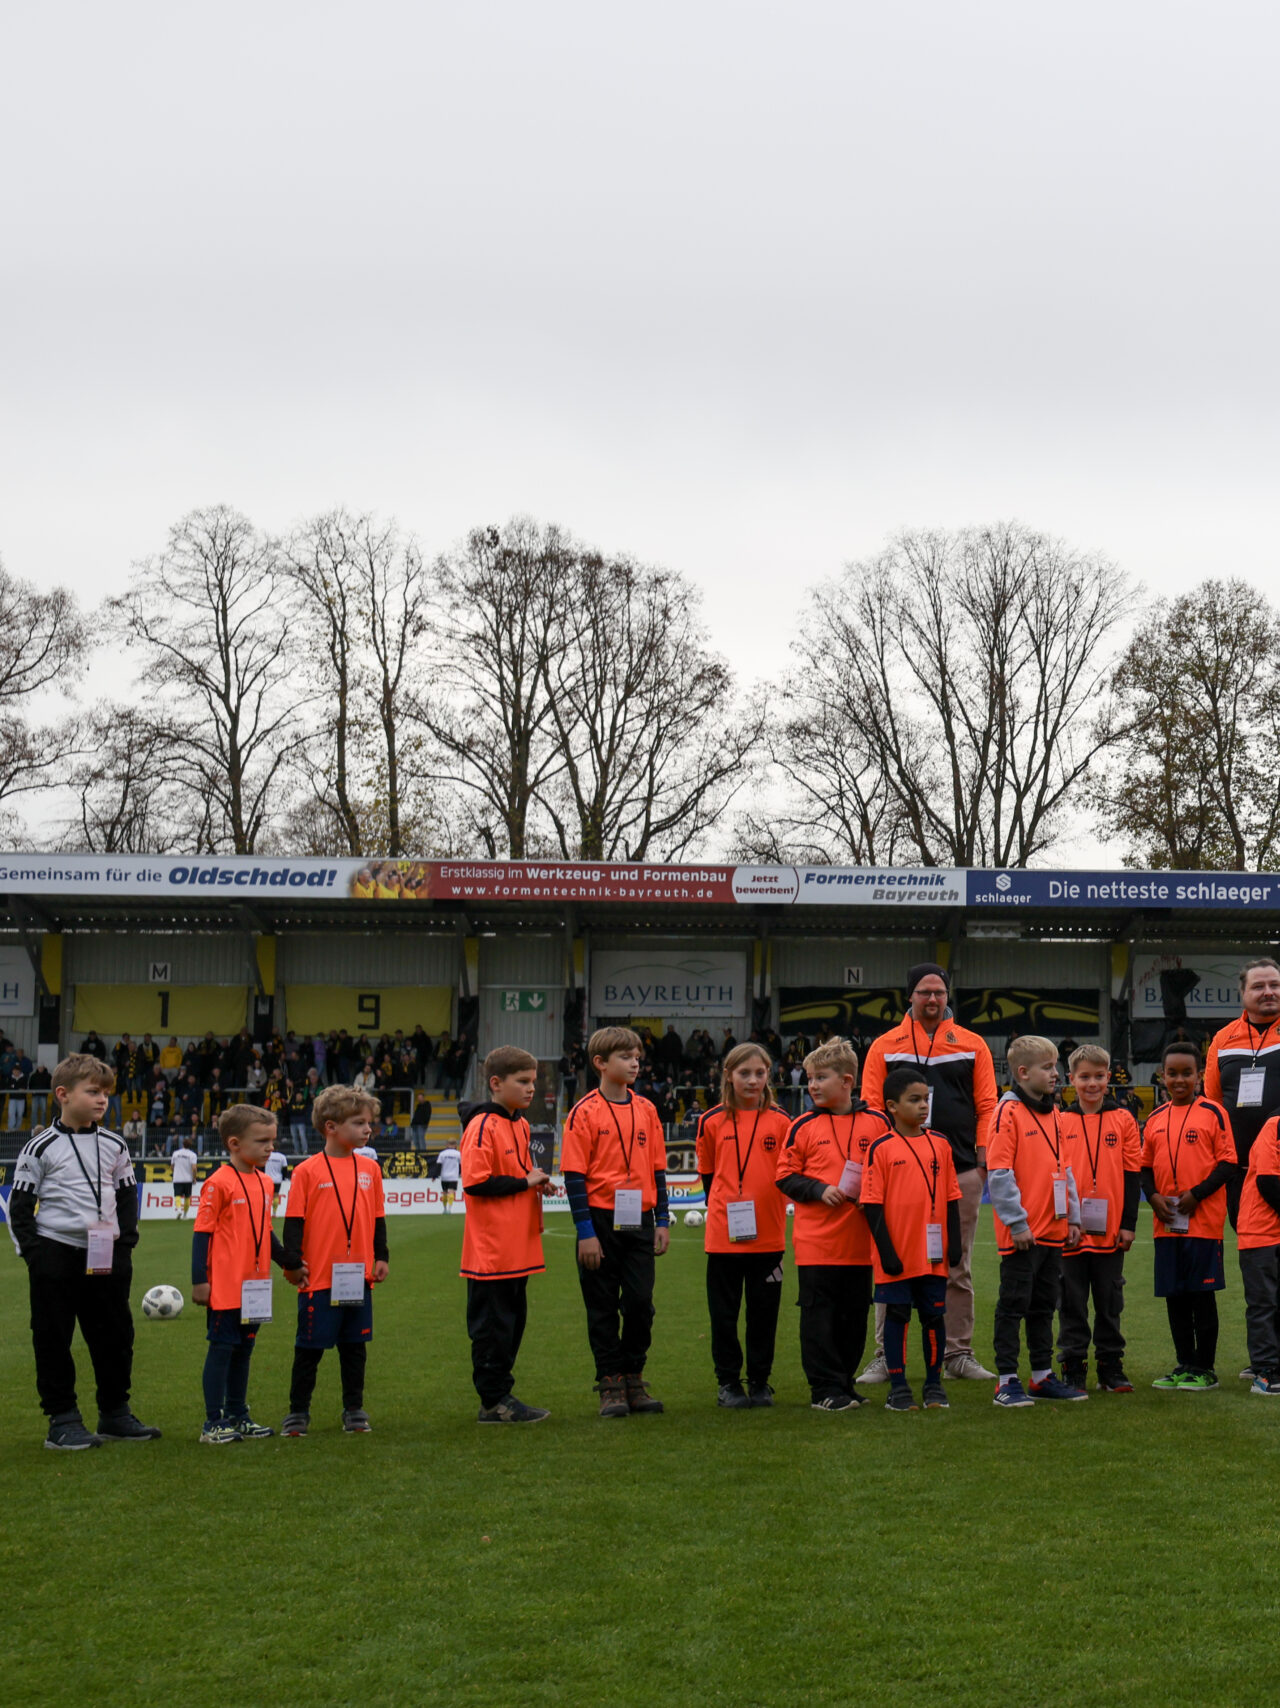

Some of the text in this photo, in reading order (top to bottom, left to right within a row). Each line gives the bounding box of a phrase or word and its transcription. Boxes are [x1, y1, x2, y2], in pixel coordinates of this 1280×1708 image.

[0, 866, 338, 887] Gemeinsam für die Oldschdod!
[440, 866, 727, 882] Erstklassig im Werkzeug- und Formenbau
[751, 875, 779, 883] Jetzt
[804, 872, 947, 886] Formentechnik
[735, 885, 795, 895] bewerben!
[872, 888, 960, 903] Bayreuth
[975, 892, 1032, 904] schlaeger
[1049, 880, 1081, 899] Die
[1087, 881, 1169, 900] netteste
[1175, 882, 1271, 904] schlaeger
[152, 964, 168, 980] M
[847, 968, 861, 984] N
[605, 985, 733, 1006] BAYREUTH
[157, 991, 170, 1028] 1
[358, 994, 381, 1030] 9
[394, 1152, 415, 1167] 35
